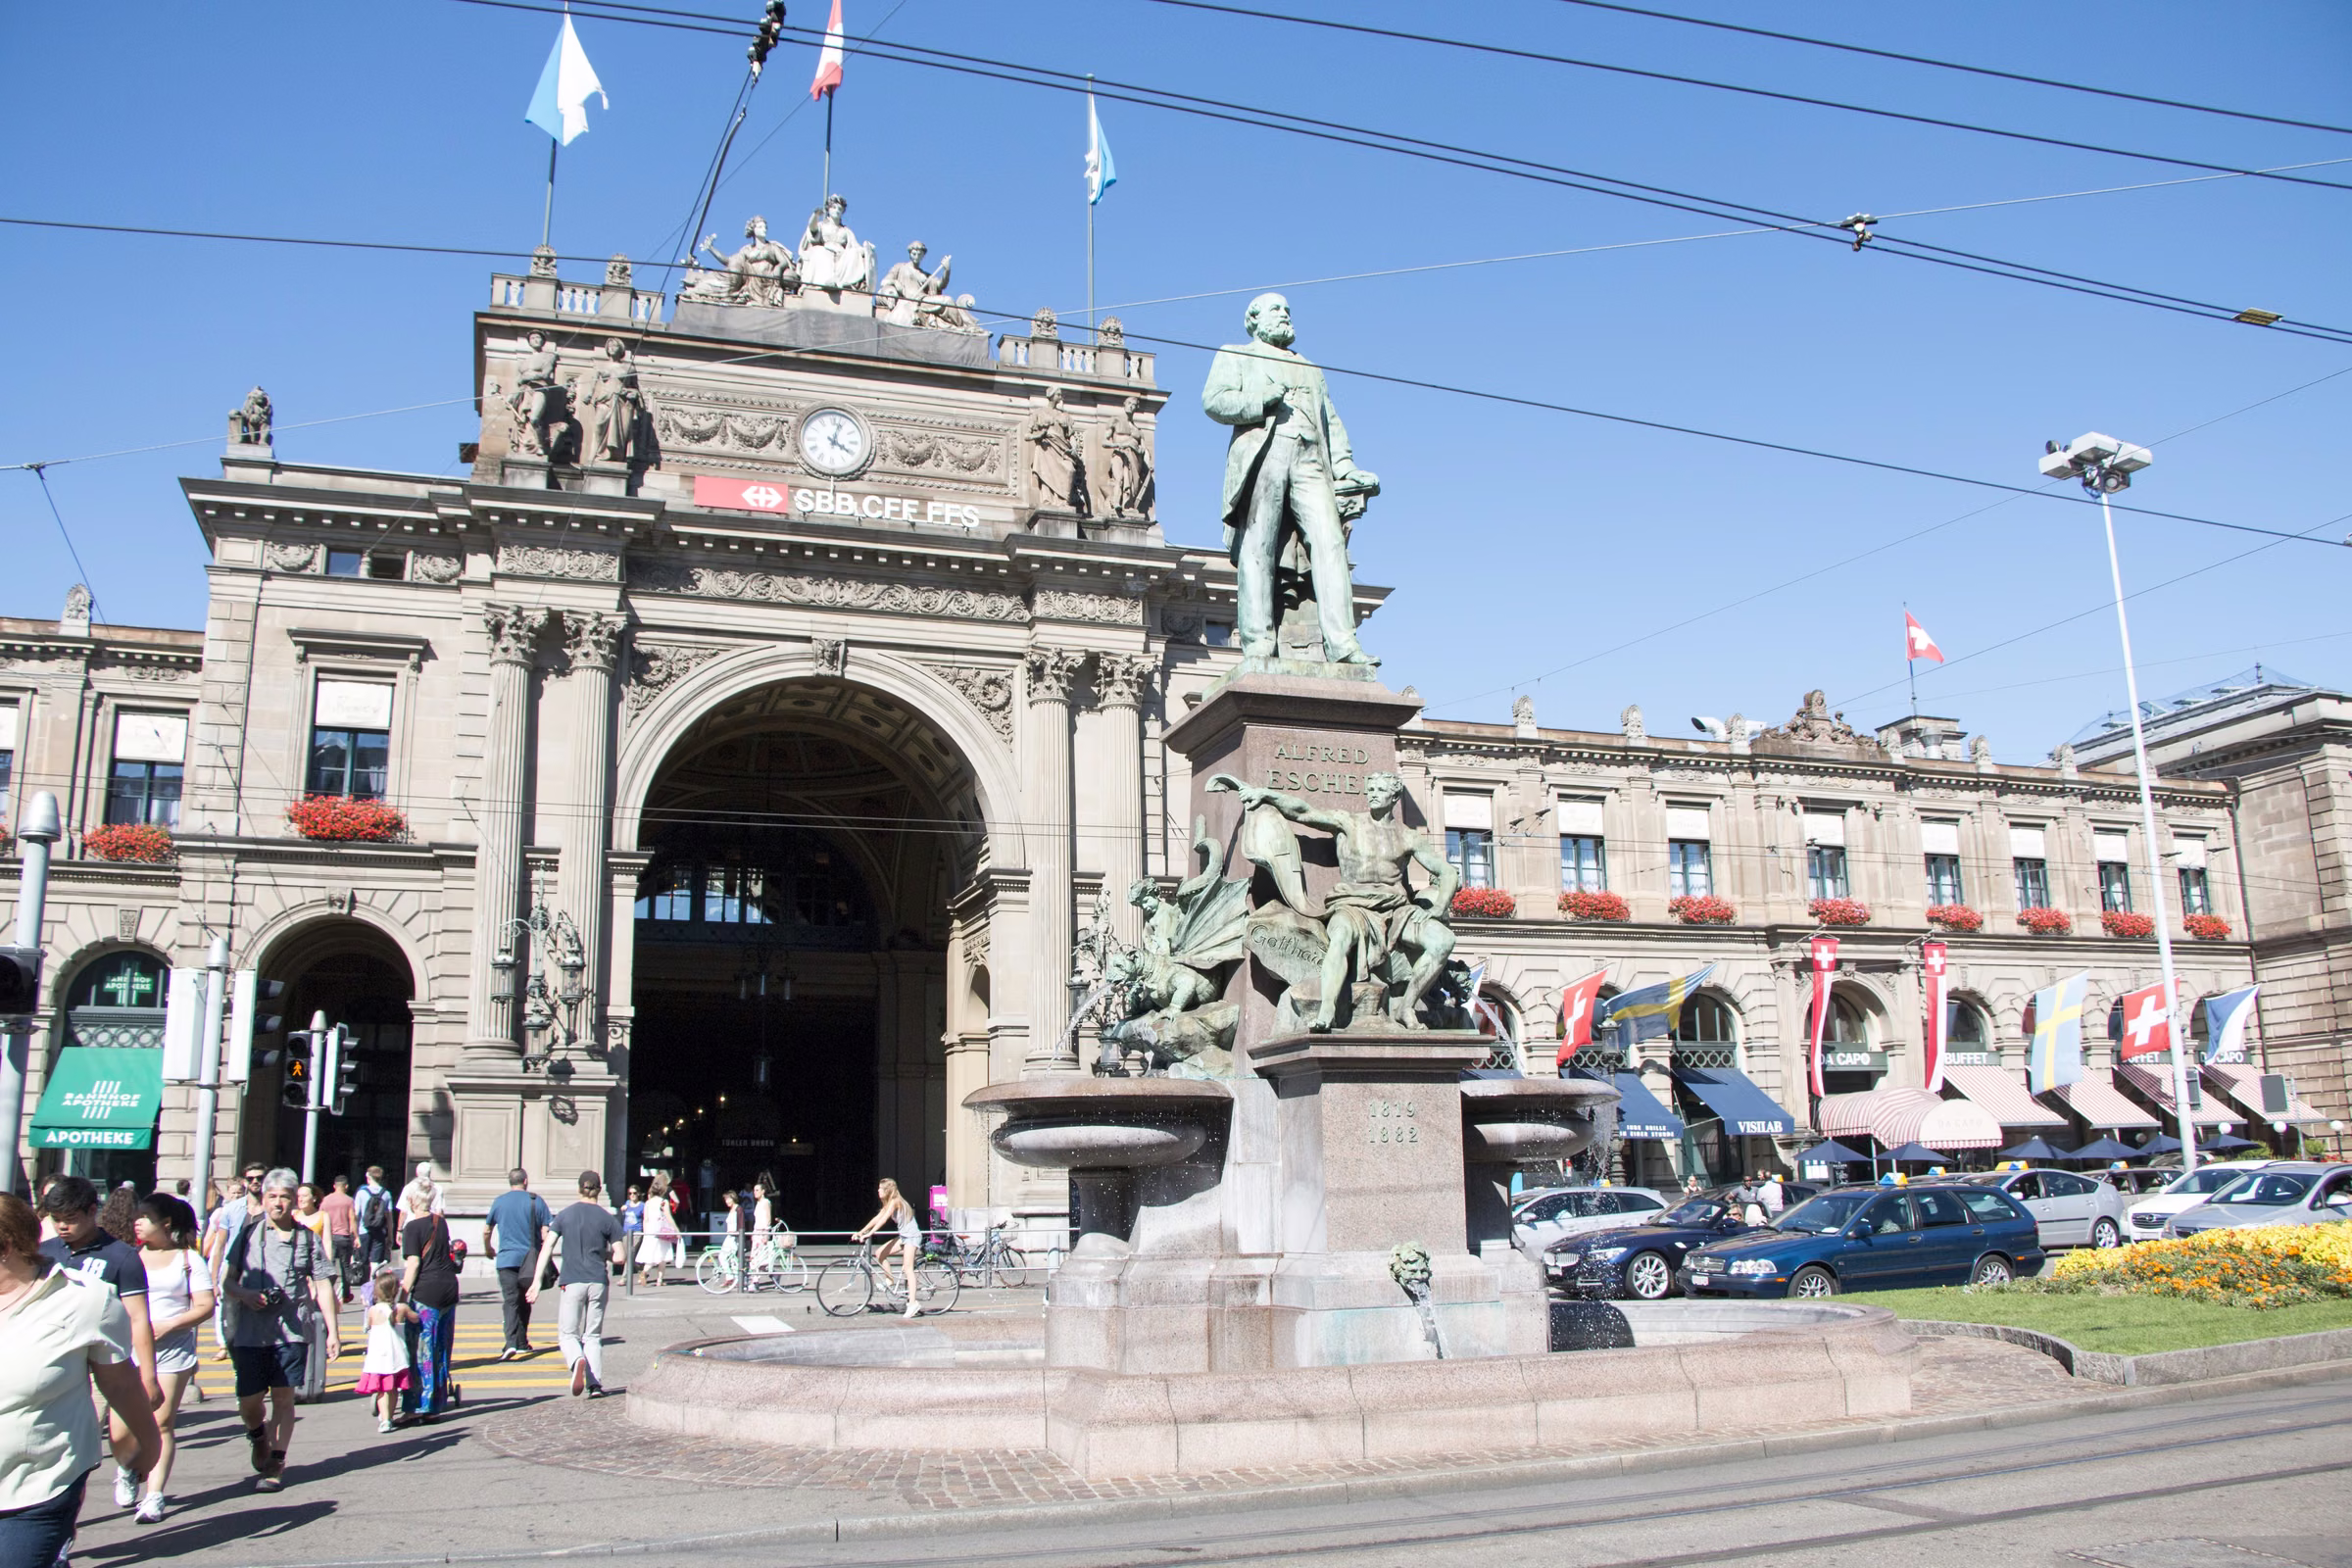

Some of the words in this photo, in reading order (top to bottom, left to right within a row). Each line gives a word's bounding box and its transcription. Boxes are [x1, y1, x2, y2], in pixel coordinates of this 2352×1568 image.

[794, 489, 856, 515] SBB
[861, 495, 919, 520] CFF
[927, 501, 980, 528] FFS
[1275, 745, 1369, 764] ALFRED
[1836, 1052, 1871, 1065] CAPO
[1944, 1052, 1988, 1065] BUFFET
[2128, 1052, 2161, 1063] FFET
[2216, 1051, 2244, 1063] CAPO
[61, 1099, 139, 1107] APOTHEKE
[64, 1092, 141, 1102] BAHNHOF
[1369, 1100, 1416, 1118] 1819
[1737, 1120, 1783, 1133] VISILAB
[45, 1130, 134, 1145] APOTHEKE
[1368, 1125, 1419, 1144] 1882
[81, 1256, 107, 1278] 18
